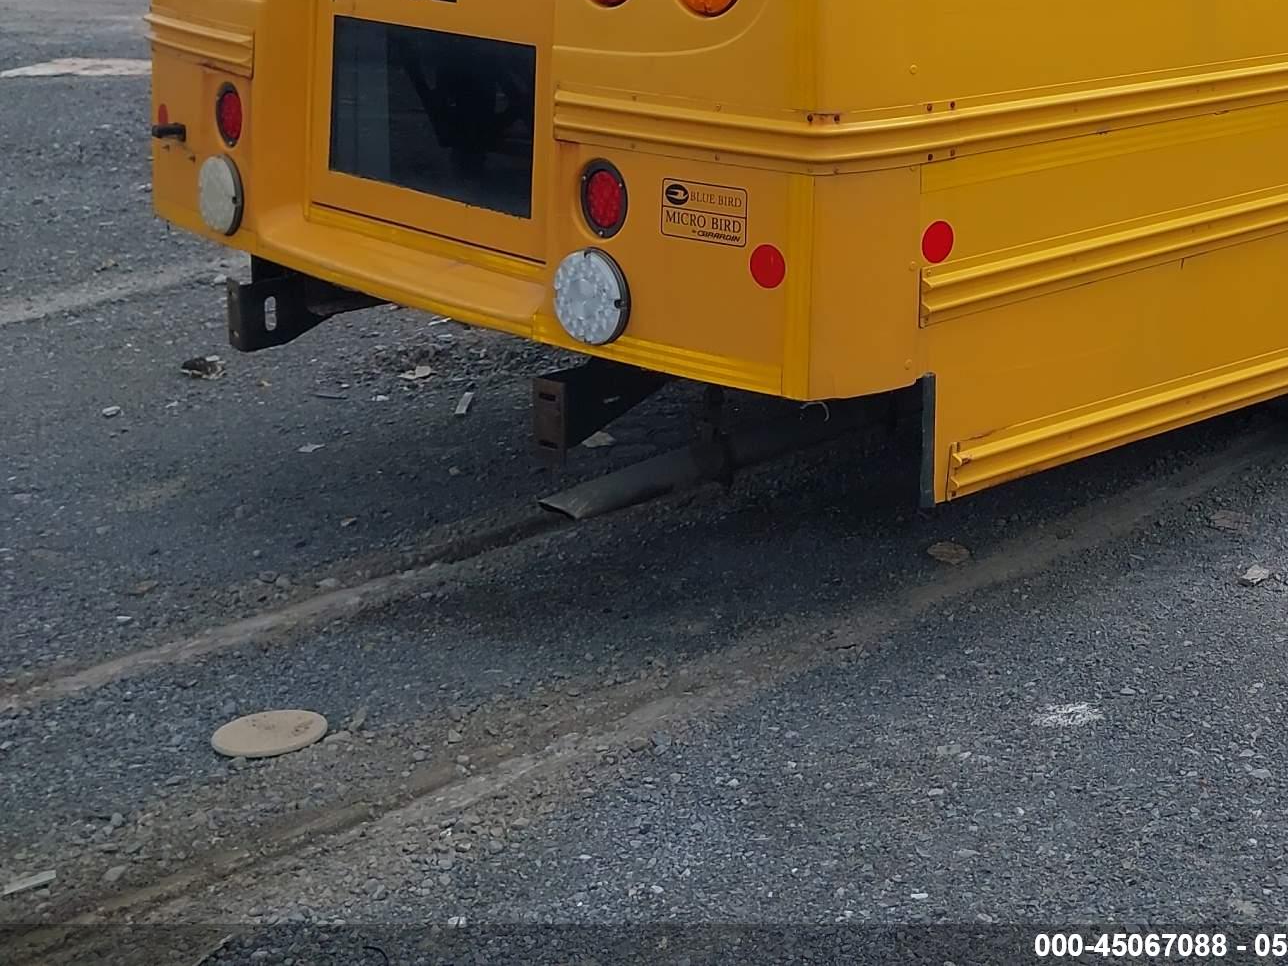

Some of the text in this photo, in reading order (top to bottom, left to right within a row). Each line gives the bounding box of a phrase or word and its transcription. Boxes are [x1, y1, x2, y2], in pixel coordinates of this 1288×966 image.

[690, 191, 742, 208] BLUE BIRD
[665, 209, 742, 234] MICRO BIRD
